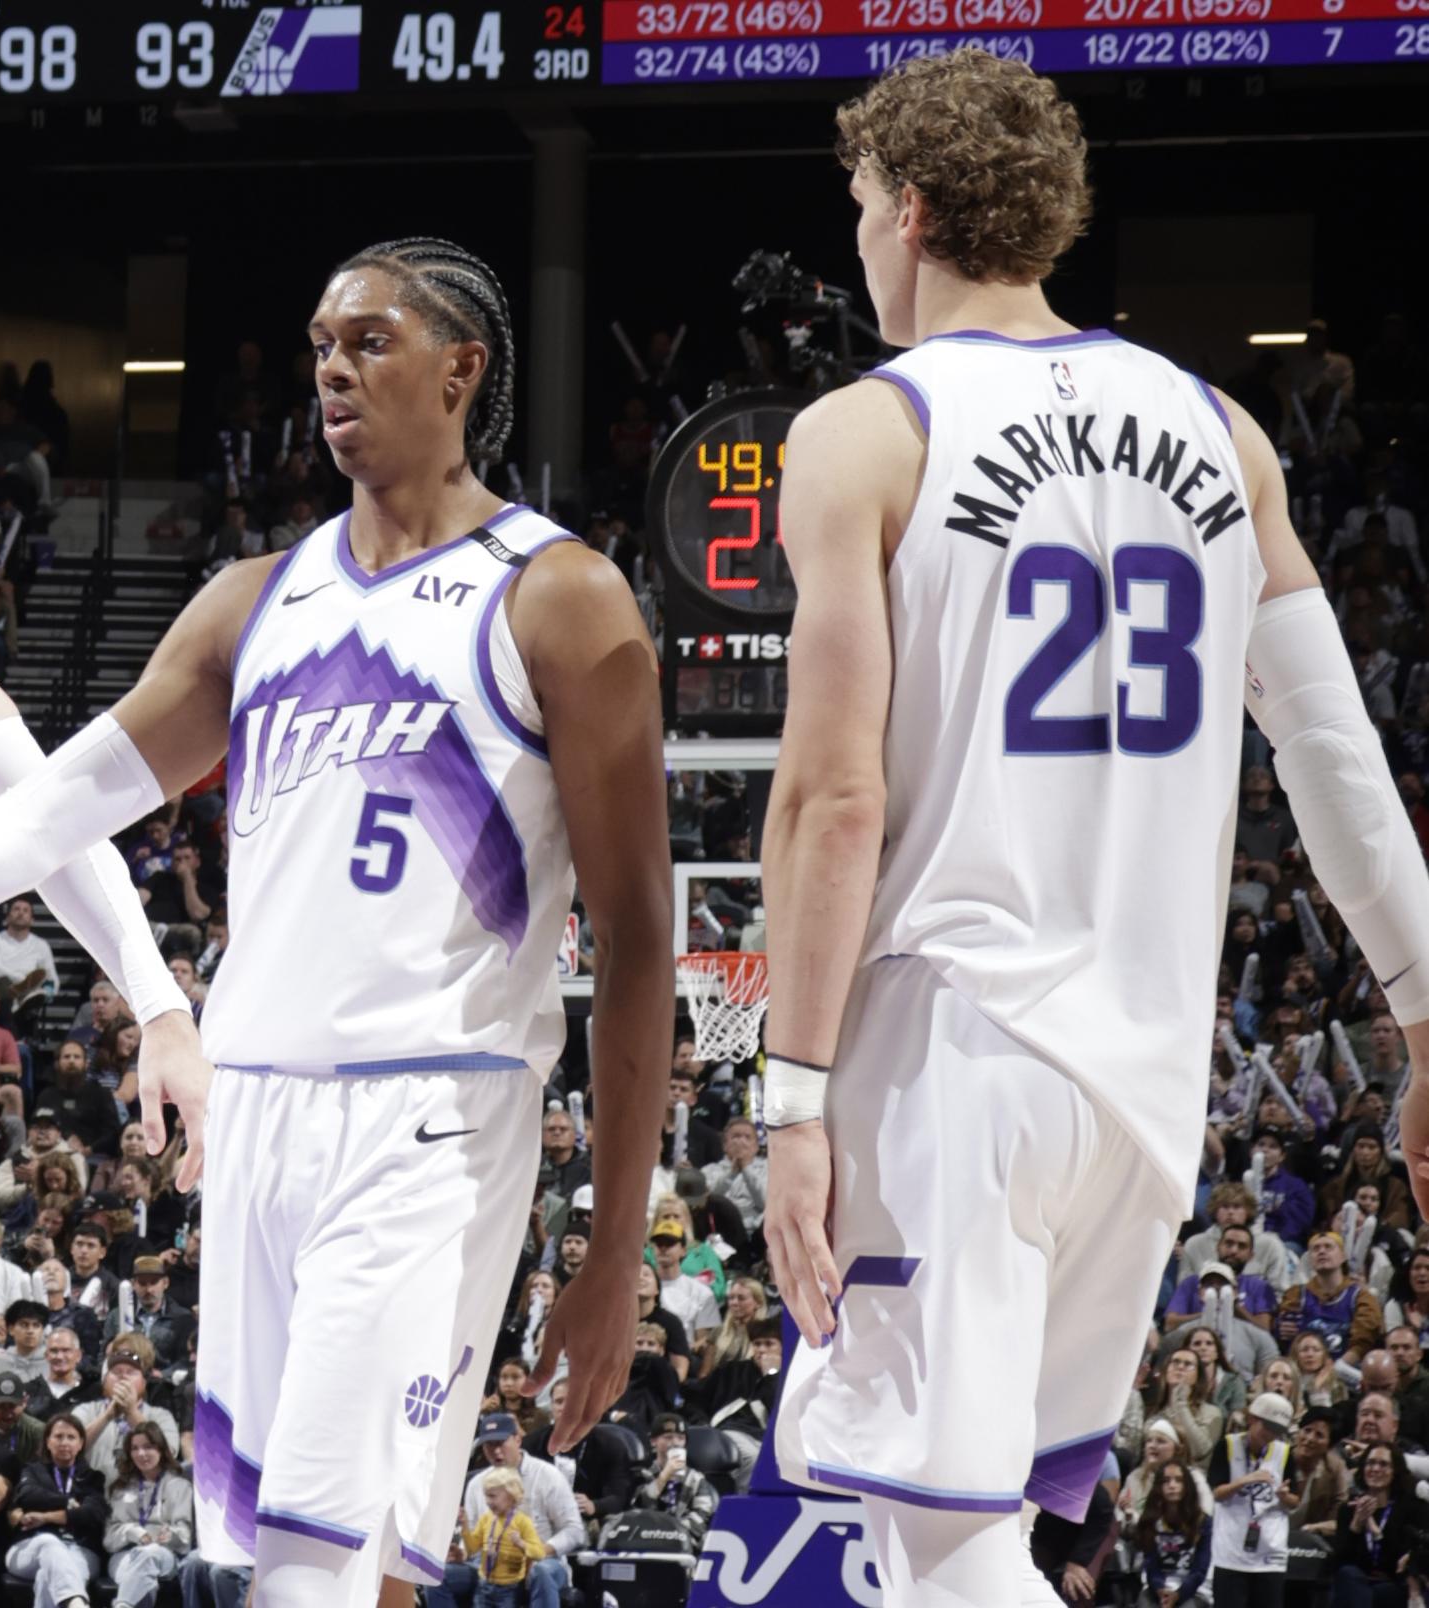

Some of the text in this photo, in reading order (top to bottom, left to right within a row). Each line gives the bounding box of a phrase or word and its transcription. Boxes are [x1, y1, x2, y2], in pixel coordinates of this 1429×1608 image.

[544, 7, 586, 39] 24
[635, 0, 823, 34] 33/72 (46%)
[859, 0, 1043, 28] 12/35 (34%)
[136, 20, 214, 89] 93
[230, 13, 276, 90] BONUS
[392, 11, 505, 81] 49.4
[634, 42, 821, 78] 32/74 (43%)
[1083, 28, 1270, 65] 18/22 (82%)
[1322, 26, 1344, 57] 7
[533, 48, 590, 80] 3RD
[944, 413, 1246, 549] MARKKANEN
[411, 574, 479, 607] LVT
[1002, 542, 1206, 758] 23
[232, 695, 460, 838] UTAH
[349, 791, 413, 896] 5
